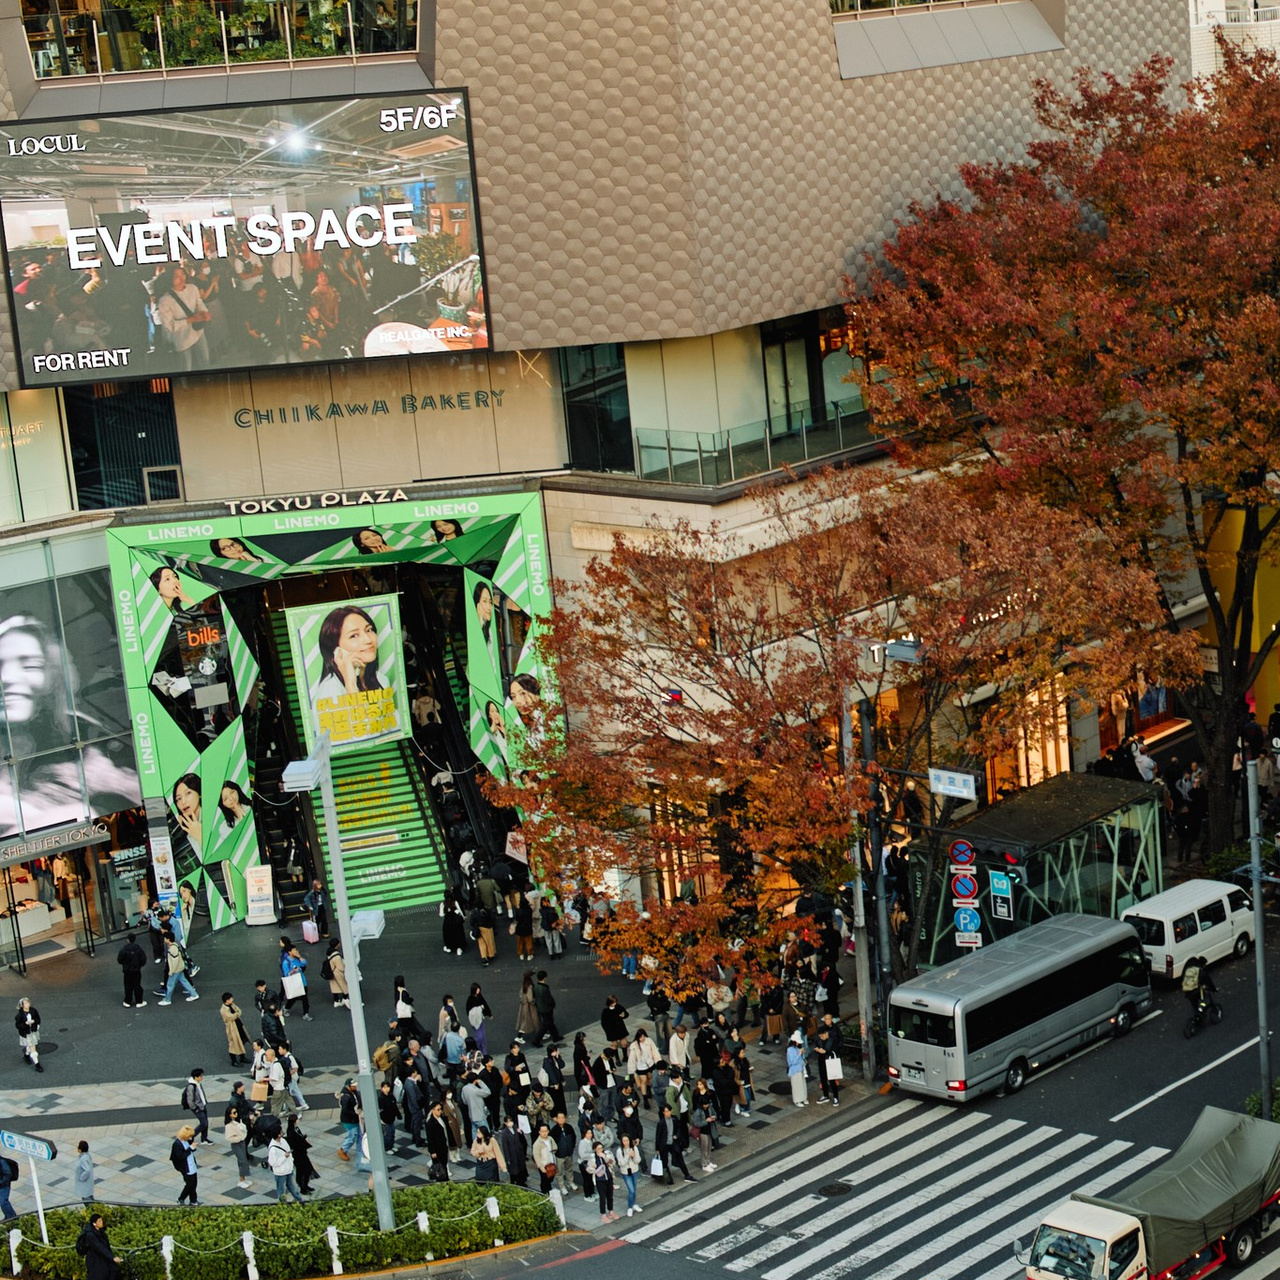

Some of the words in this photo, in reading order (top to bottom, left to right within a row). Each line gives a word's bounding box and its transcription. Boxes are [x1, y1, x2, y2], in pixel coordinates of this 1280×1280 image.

[380, 104, 457, 132] 5F/6F
[8, 134, 86, 156] LOCUL
[66, 216, 236, 270] EVENT
[247, 203, 418, 255] SPACE
[33, 352, 75, 373] FOR
[77, 348, 131, 369] RENT
[234, 400, 389, 428] CHIIKAWA
[402, 389, 505, 415] BAKERY
[225, 496, 312, 516] TOKYU
[321, 489, 409, 508] PLAZA
[413, 501, 479, 518] LINEMO
[147, 523, 214, 541] LINEMO
[273, 513, 340, 530] LINEMO
[527, 533, 544, 597] LINEMO
[118, 589, 138, 653] LINEMO
[187, 626, 220, 647] bills
[136, 712, 155, 774] LINEMO
